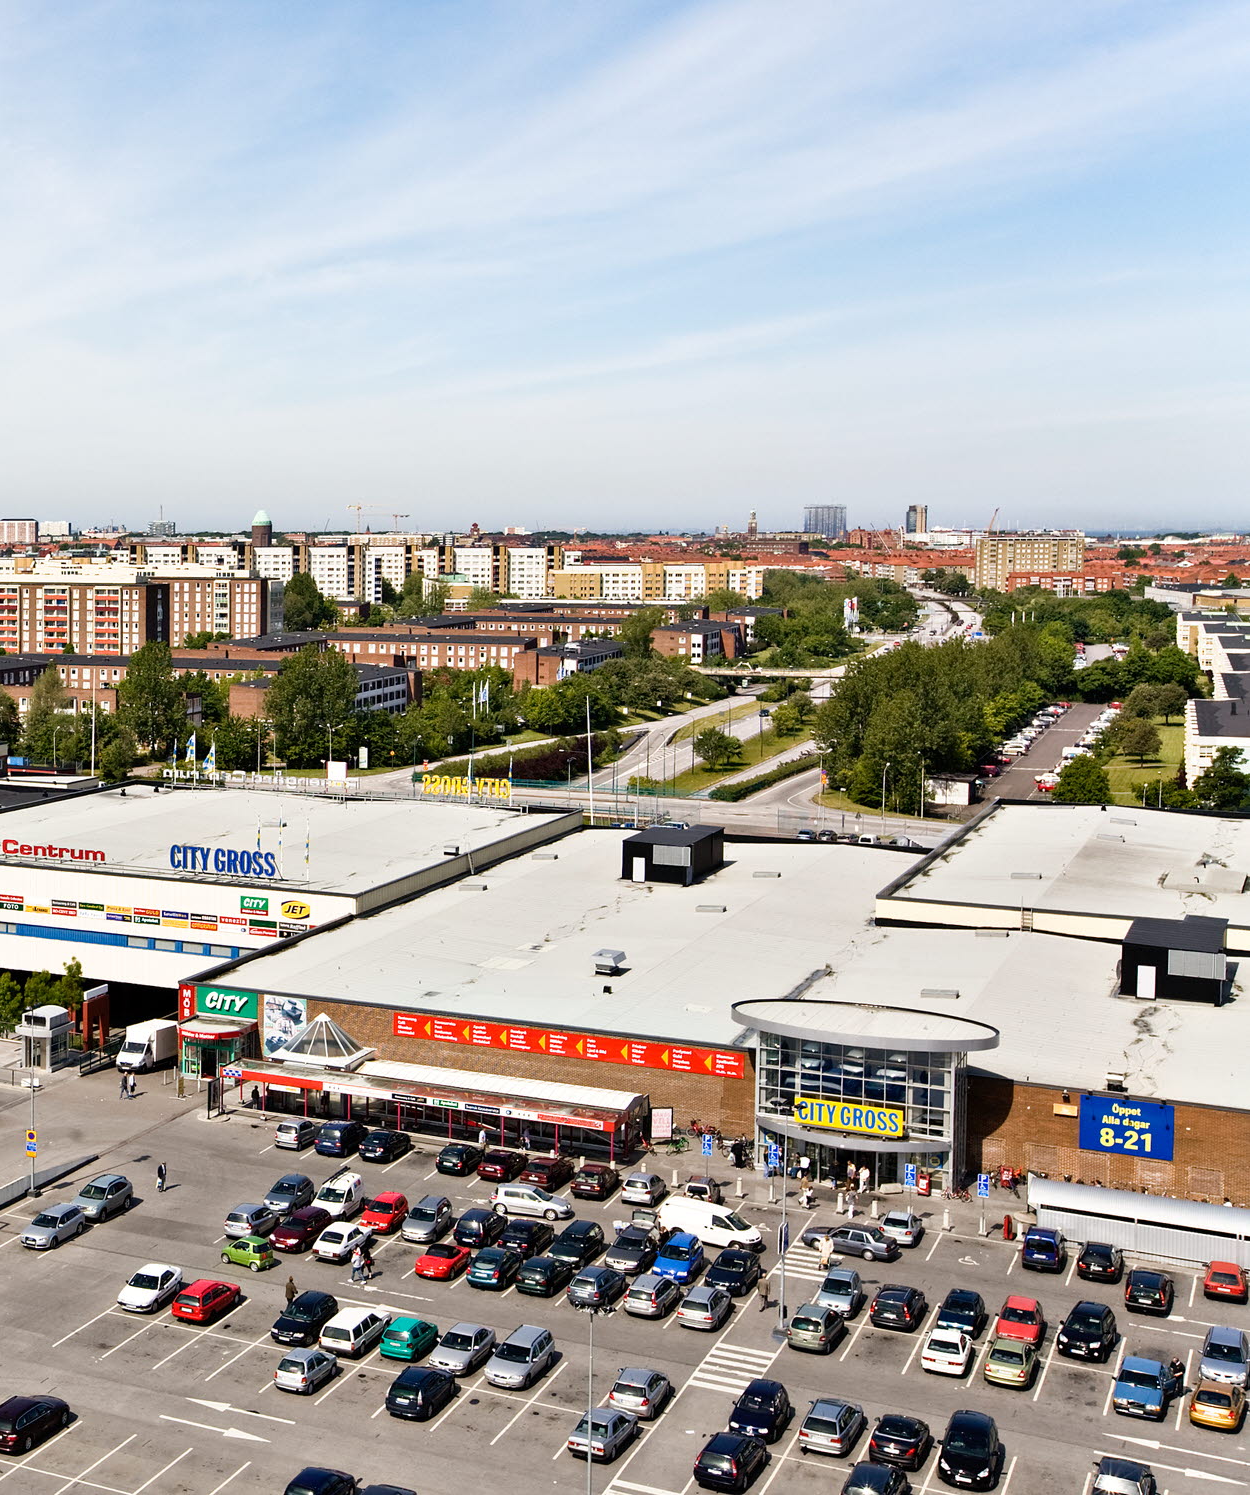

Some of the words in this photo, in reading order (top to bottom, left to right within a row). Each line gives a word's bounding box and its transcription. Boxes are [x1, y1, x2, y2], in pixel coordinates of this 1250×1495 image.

[2, 839, 106, 862] Centrum
[170, 844, 211, 871] CITY
[214, 848, 276, 876] GROSS
[243, 898, 266, 908] CITY
[285, 905, 306, 915] JET
[221, 917, 246, 925] venezia
[205, 991, 249, 1012] CITY
[798, 1101, 836, 1123] CITY
[840, 1106, 899, 1132] GROSS
[1112, 1103, 1141, 1116] Öppet
[1102, 1115, 1120, 1125] Alla
[1122, 1118, 1150, 1130] dagar
[1100, 1128, 1152, 1152] 8-21
